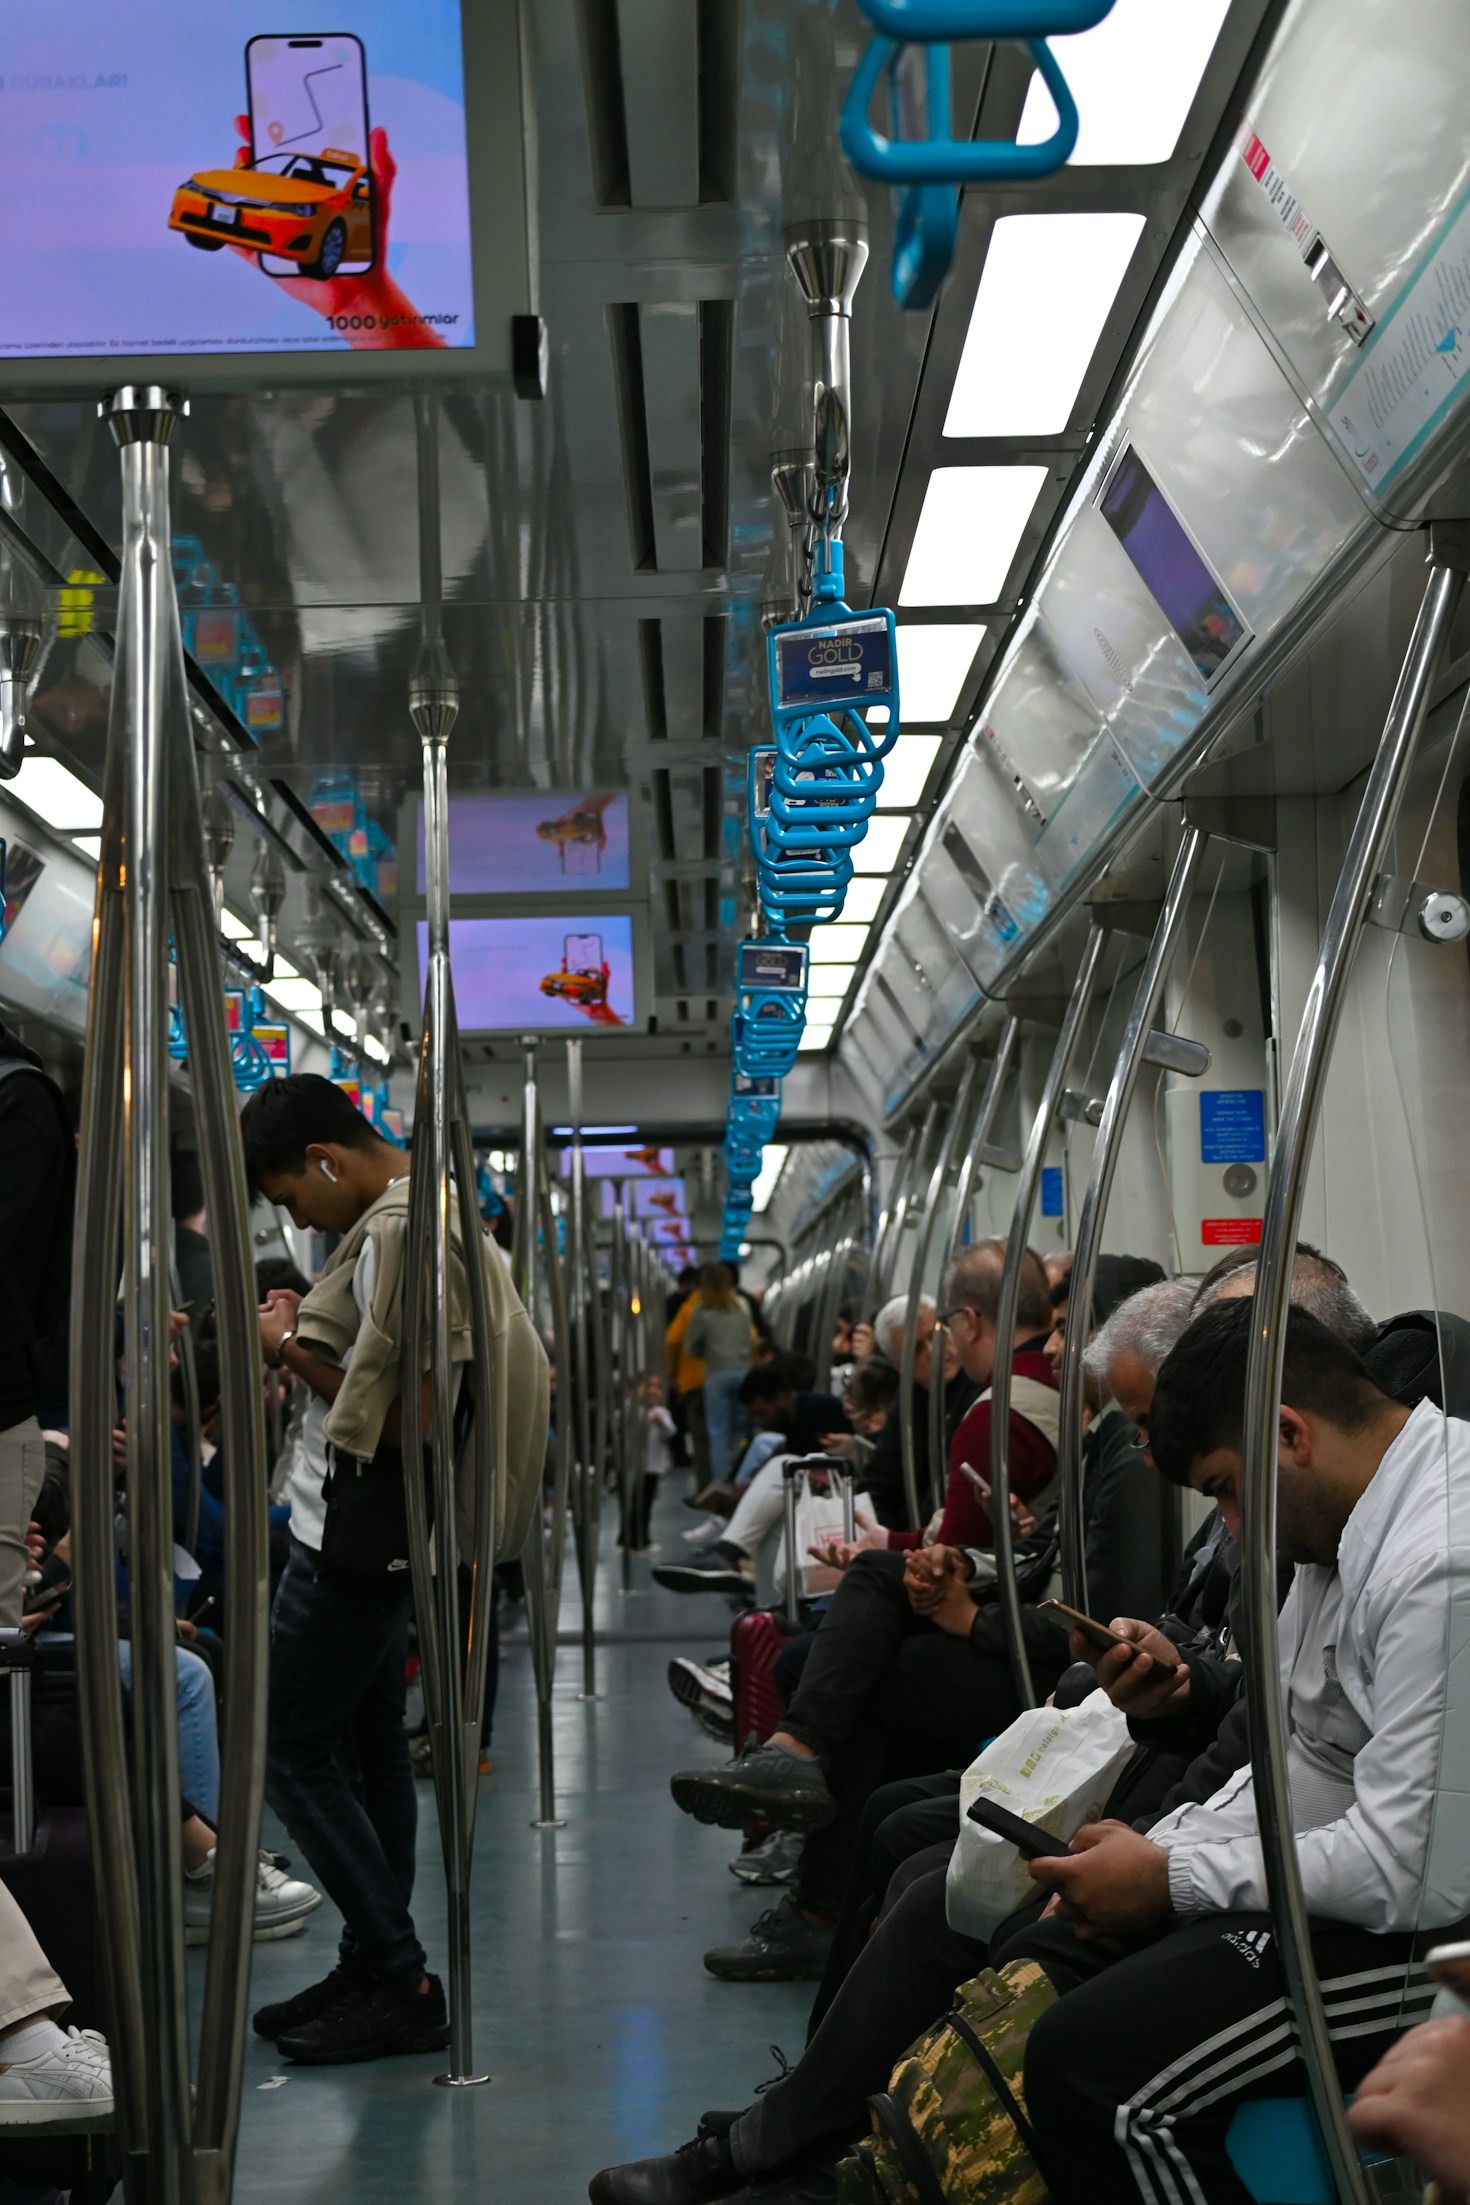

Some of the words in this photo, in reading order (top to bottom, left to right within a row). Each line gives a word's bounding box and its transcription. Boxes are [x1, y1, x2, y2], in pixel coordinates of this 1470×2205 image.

[326, 314, 377, 331] 1000
[807, 642, 864, 665] GOLD
[815, 665, 857, 676] nadirgold.com
[1220, 1932, 1261, 1969] adidas
